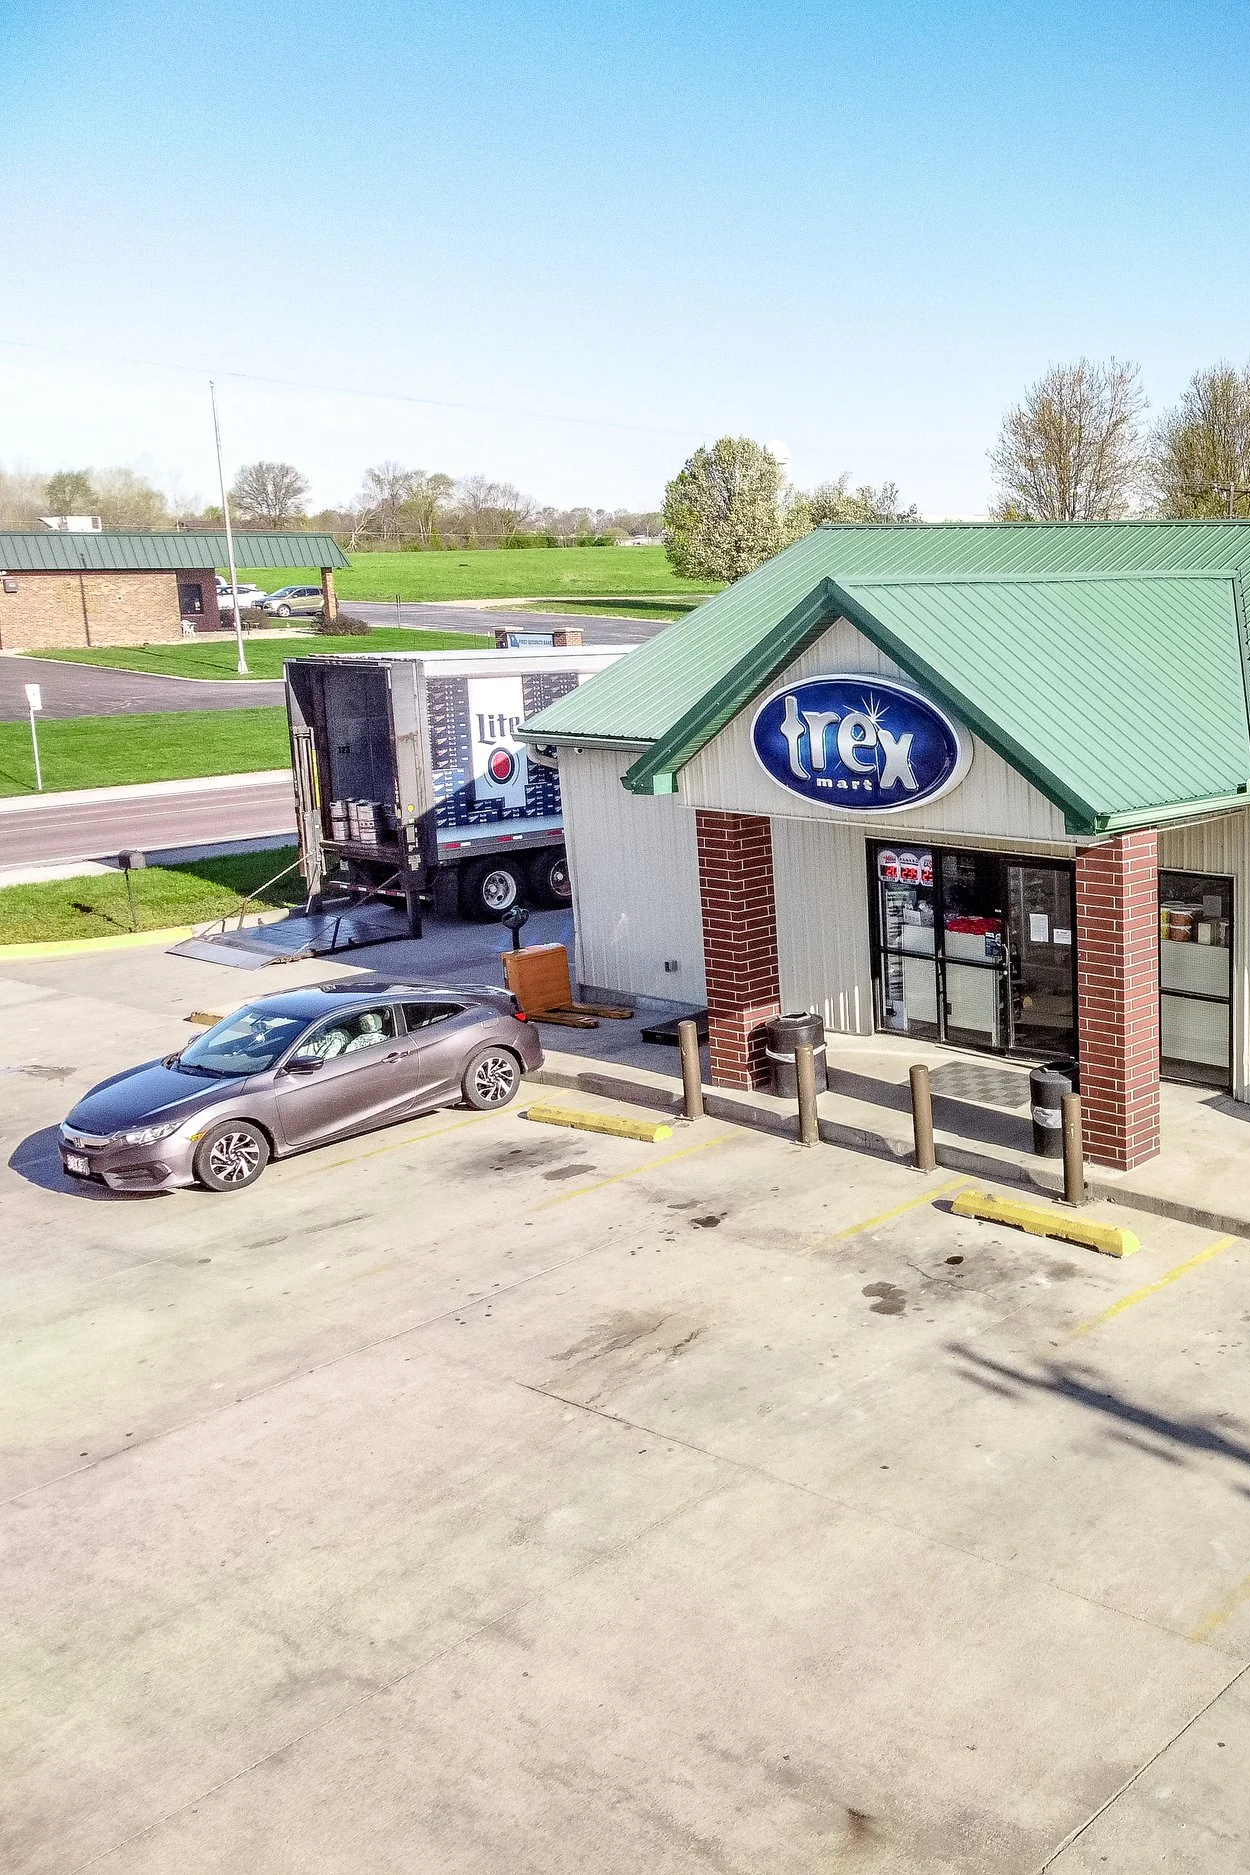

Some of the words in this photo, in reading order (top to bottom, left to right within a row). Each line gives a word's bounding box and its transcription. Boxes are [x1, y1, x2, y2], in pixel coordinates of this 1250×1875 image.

[475, 714, 520, 745] Lite
[780, 695, 919, 791] trex
[816, 778, 873, 791] mart
